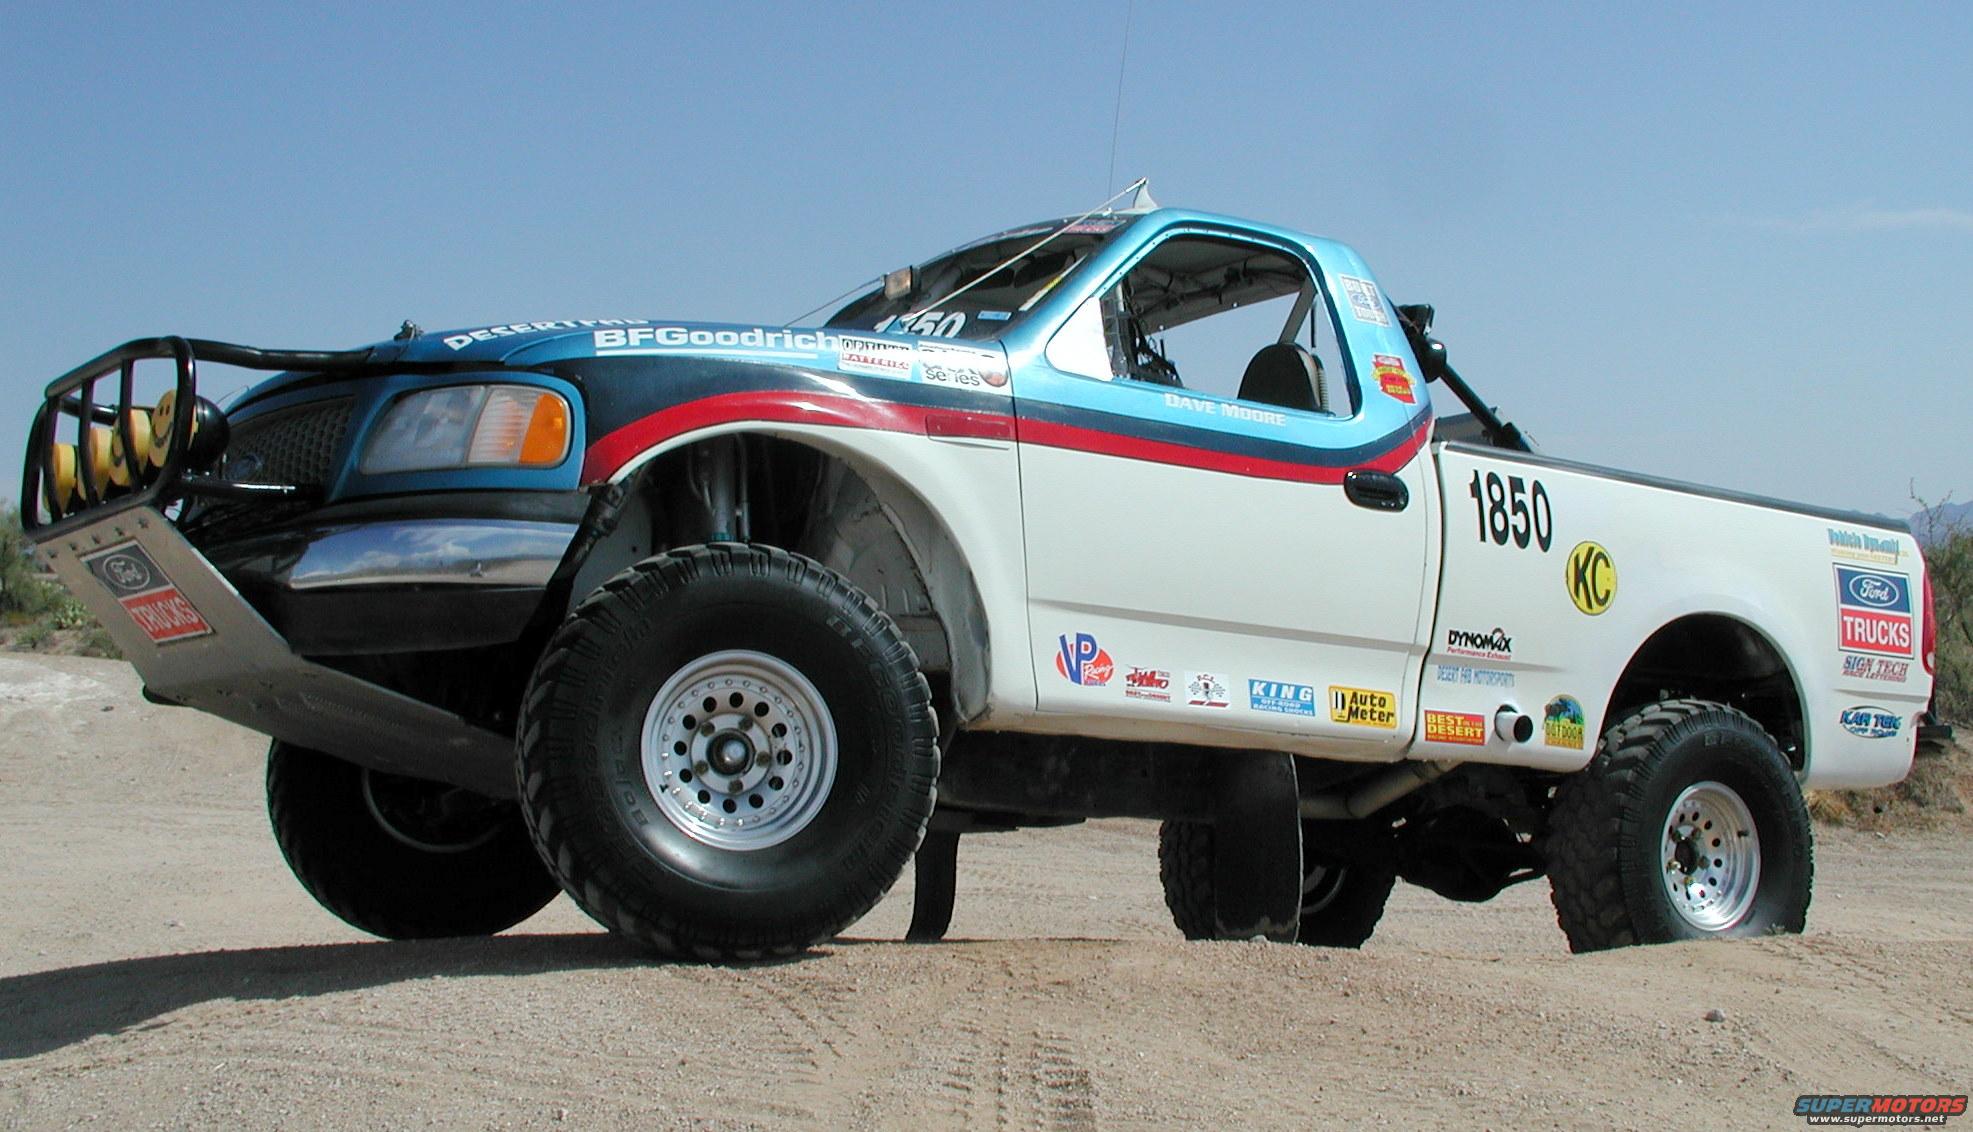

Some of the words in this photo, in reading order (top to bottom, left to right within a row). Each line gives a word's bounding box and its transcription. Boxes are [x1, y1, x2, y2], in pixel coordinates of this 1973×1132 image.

[593, 327, 840, 350] BFGoodrich
[925, 367, 981, 387] seies
[1164, 393, 1217, 415] DAVE
[1221, 403, 1287, 426] MOORE
[1469, 469, 1552, 553] 1850
[111, 560, 143, 583] Ford
[1573, 546, 1611, 610] KC
[1860, 578, 1890, 601] Ford
[130, 596, 200, 632] TRUCKS
[1448, 628, 1512, 653] DYNOMAX
[1843, 616, 1911, 648] TRUCKS
[1059, 632, 1098, 685] VP
[1843, 655, 1873, 672] SIGN
[1876, 659, 1909, 677] TECH
[1252, 681, 1313, 701] KING
[1350, 691, 1386, 708] Auto
[1348, 706, 1395, 723] Meter
[1427, 713, 1465, 726] BEST
[1427, 725, 1484, 738] DESERT
